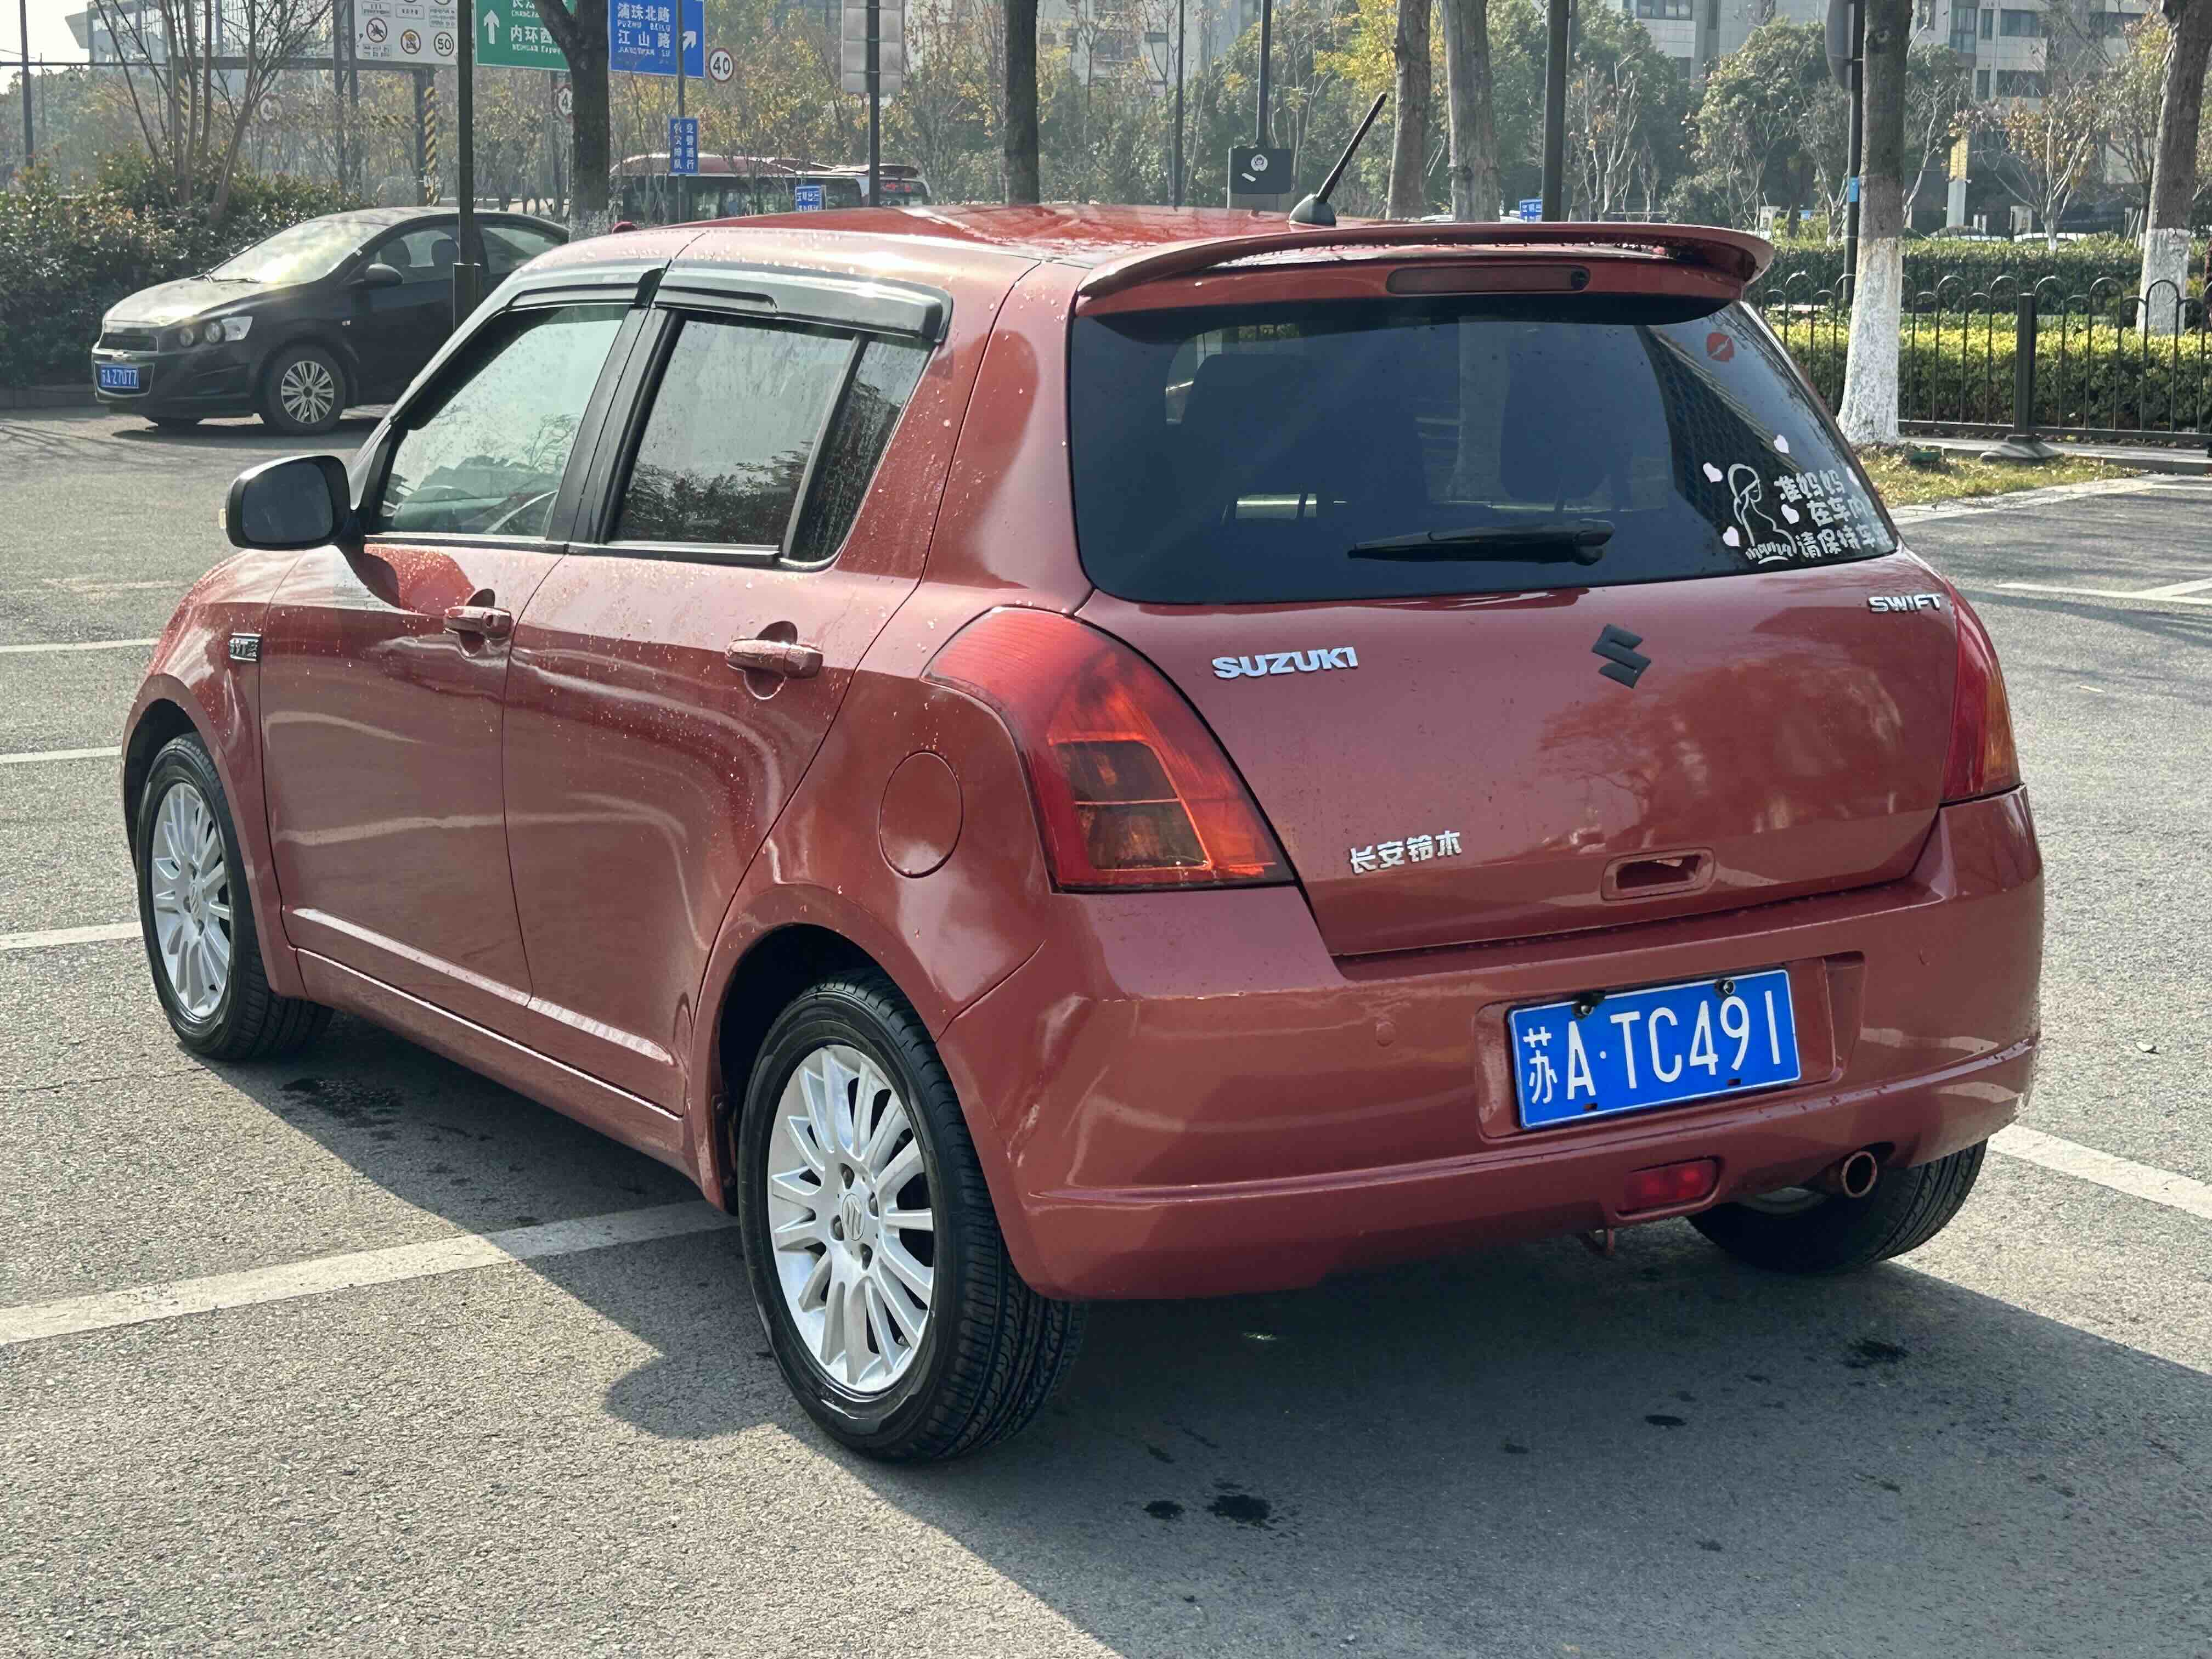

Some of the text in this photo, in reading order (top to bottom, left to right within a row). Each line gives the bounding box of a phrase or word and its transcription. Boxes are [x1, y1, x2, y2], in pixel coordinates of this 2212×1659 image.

[438, 38, 452, 50] 50
[618, 29, 670, 48] 江山路
[713, 57, 730, 75] 40
[1774, 469, 1846, 503] 准妈妈
[1868, 592, 1943, 613] SWIFT
[1211, 646, 1359, 679] SUZUKI
[1350, 830, 1463, 874] 长安铃木
